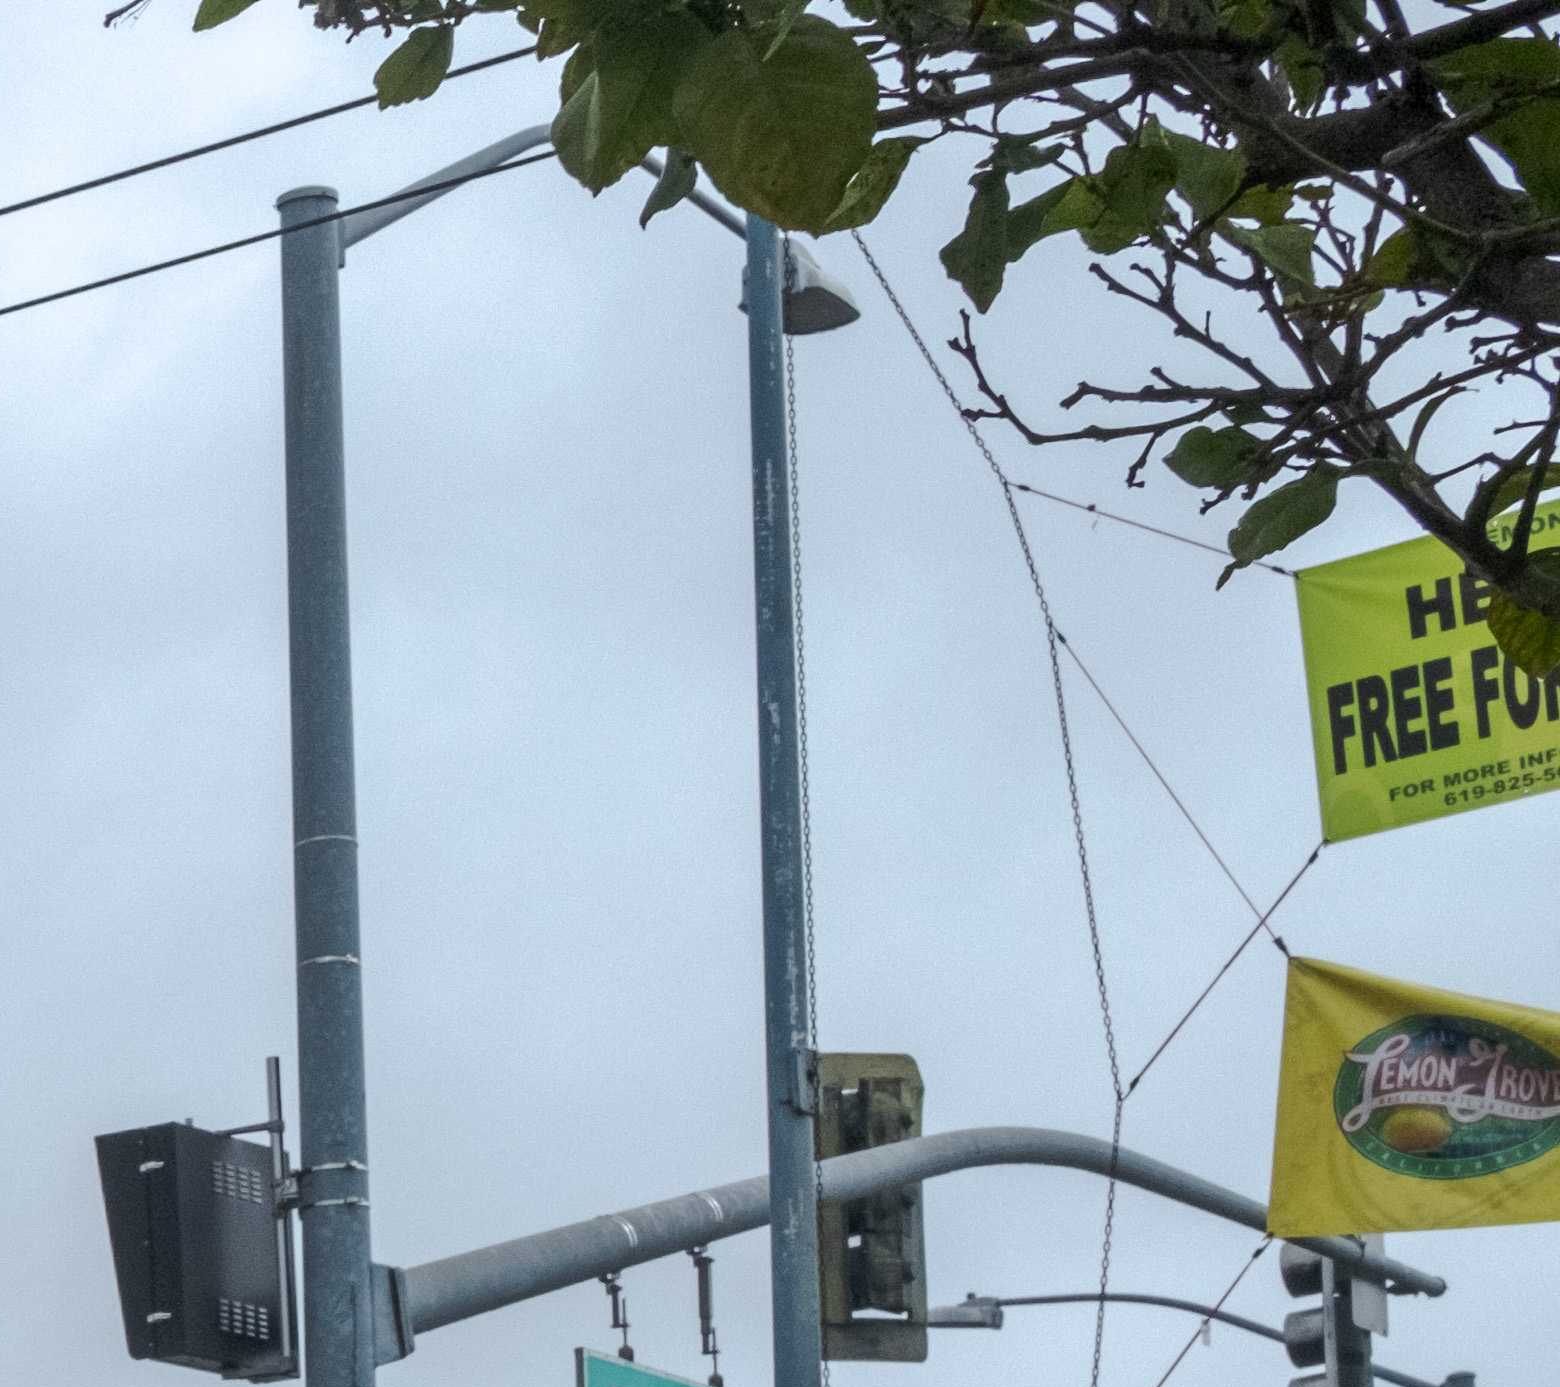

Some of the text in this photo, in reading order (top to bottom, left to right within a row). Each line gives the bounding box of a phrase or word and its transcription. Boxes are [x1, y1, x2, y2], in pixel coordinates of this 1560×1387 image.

[1406, 574, 1491, 640] HE
[1327, 655, 1460, 776] FREE
[1389, 748, 1560, 802] FOR MORE INF
